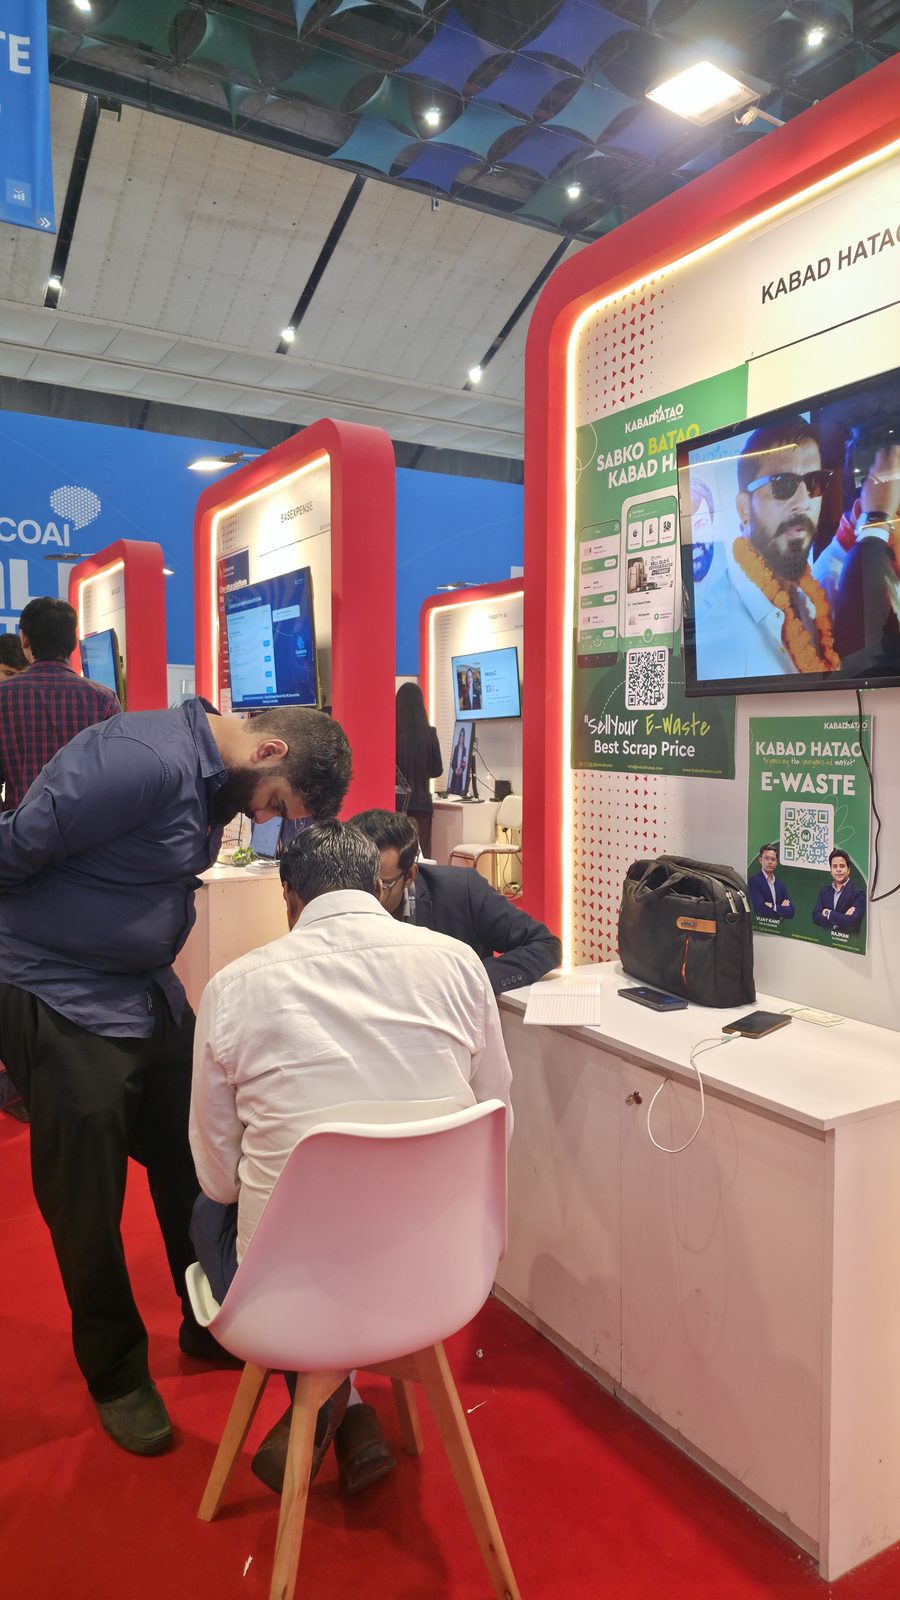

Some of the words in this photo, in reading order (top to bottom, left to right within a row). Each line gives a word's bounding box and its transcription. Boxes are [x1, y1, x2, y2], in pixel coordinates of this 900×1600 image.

[0, 30, 31, 75] E
[762, 257, 831, 304] KABAD
[838, 224, 900, 271] HATA
[597, 441, 644, 472] SABKO
[648, 423, 700, 455] BATAO
[608, 459, 657, 489] KABAD
[281, 501, 313, 523] EASEXPENSE
[645, 711, 711, 736] E-Waste
[594, 740, 619, 754] Best
[623, 740, 656, 758] Scrap
[661, 740, 695, 757] Price
[755, 741, 806, 756] KABAD
[810, 741, 862, 757] HATAO
[761, 771, 856, 796] E-WASTE
[831, 930, 849, 939] RAJMAN
